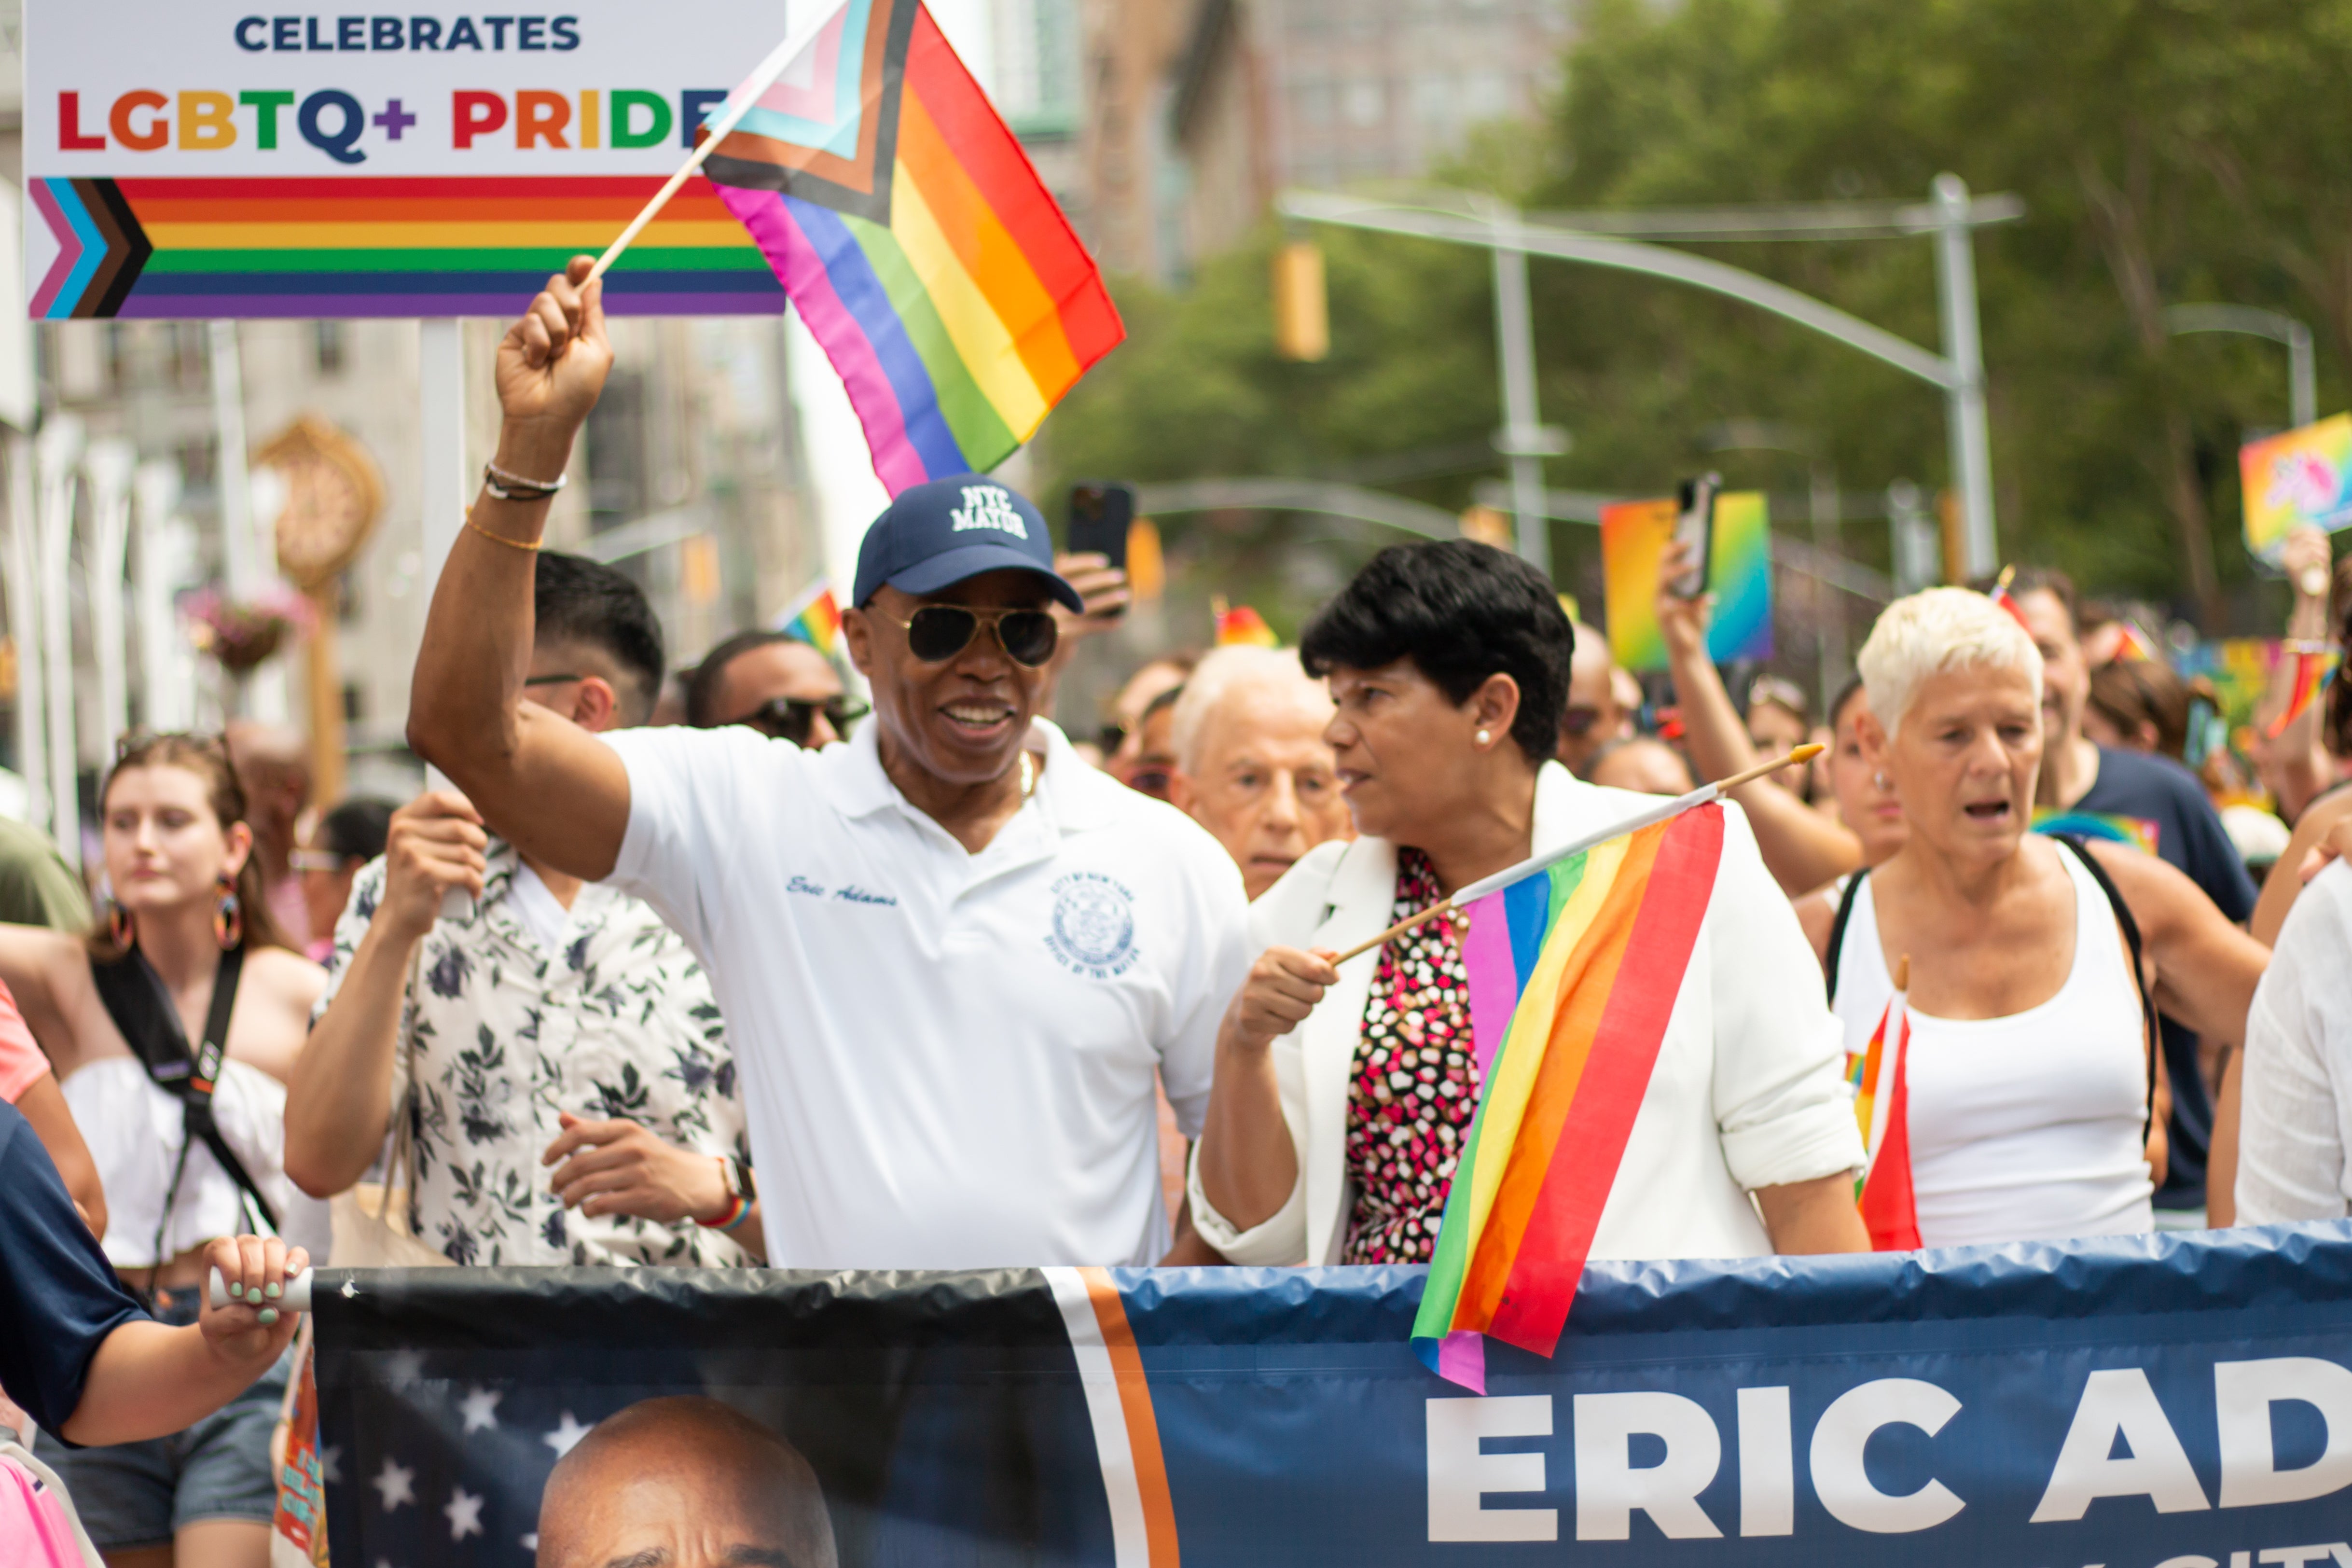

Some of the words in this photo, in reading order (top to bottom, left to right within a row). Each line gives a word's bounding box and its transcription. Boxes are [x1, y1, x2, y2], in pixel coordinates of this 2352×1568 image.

[235, 15, 580, 52] CELEBRATES
[58, 89, 416, 165] LGBTQ+
[960, 486, 1012, 511] NYC
[949, 507, 1028, 540] MAYOR
[787, 875, 825, 896] Eric
[831, 884, 897, 906] Adams
[1426, 1377, 1966, 1542] ERIC
